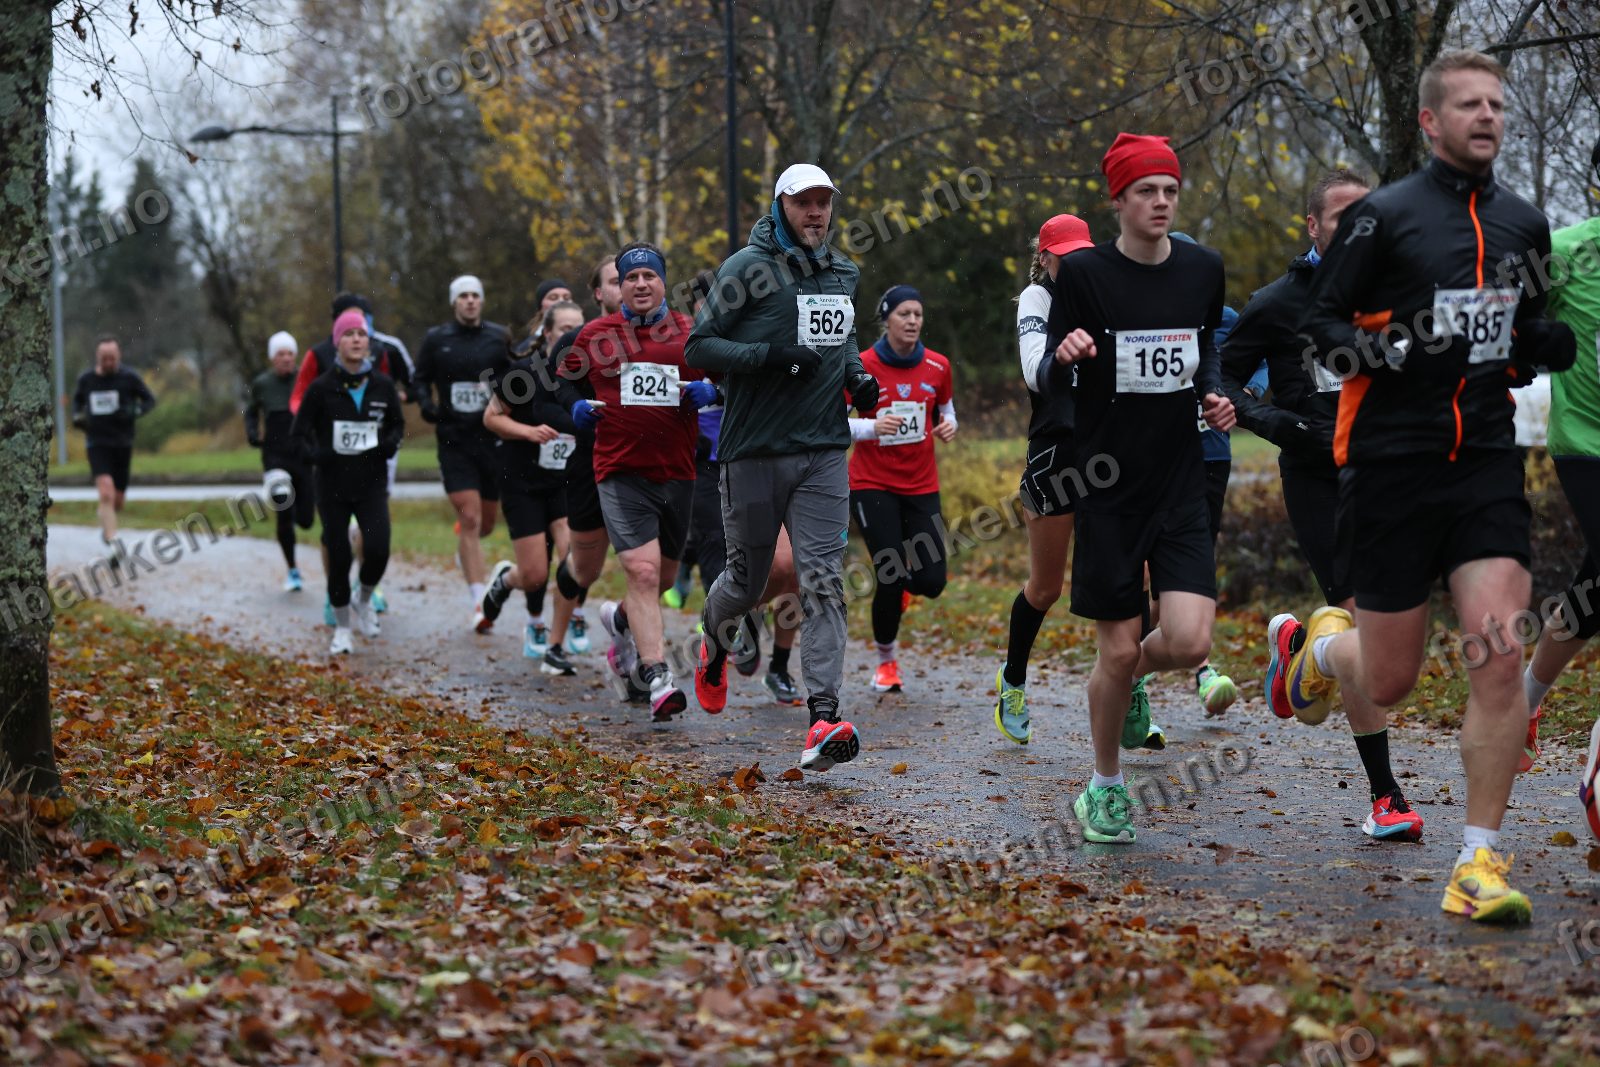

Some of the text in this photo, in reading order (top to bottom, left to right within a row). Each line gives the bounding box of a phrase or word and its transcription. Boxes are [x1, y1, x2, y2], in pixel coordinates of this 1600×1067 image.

[810, 310, 844, 335] 562
[1455, 311, 1505, 344] 385
[1124, 334, 1192, 343] NORGESTESTEN
[1135, 347, 1184, 377] 165
[633, 375, 668, 396] 824
[898, 416, 918, 435] 64
[342, 432, 366, 448] 671
[553, 443, 568, 460] 82
